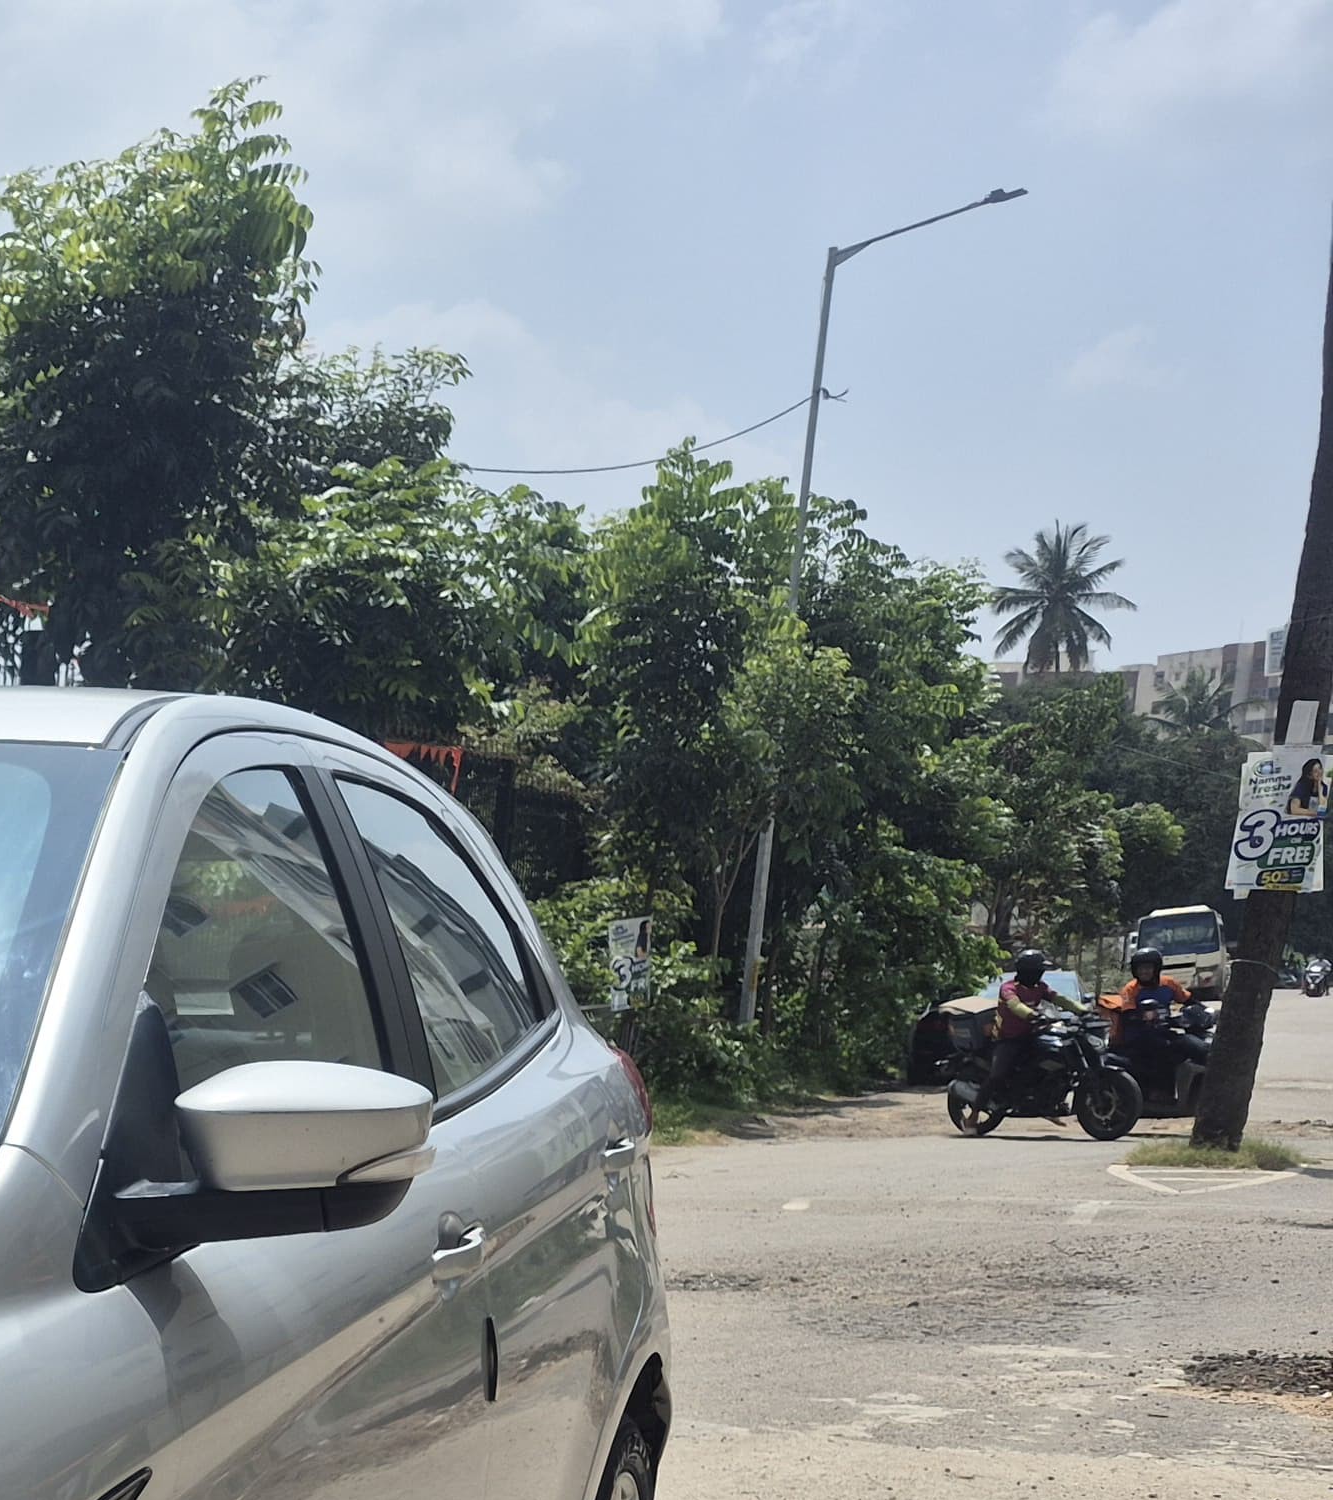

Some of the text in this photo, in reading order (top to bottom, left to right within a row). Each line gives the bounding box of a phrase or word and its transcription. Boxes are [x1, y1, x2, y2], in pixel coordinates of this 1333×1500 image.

[1249, 775, 1292, 786] Namma
[1234, 809, 1319, 861] 3 HOURS
[1266, 846, 1312, 866] FREE
